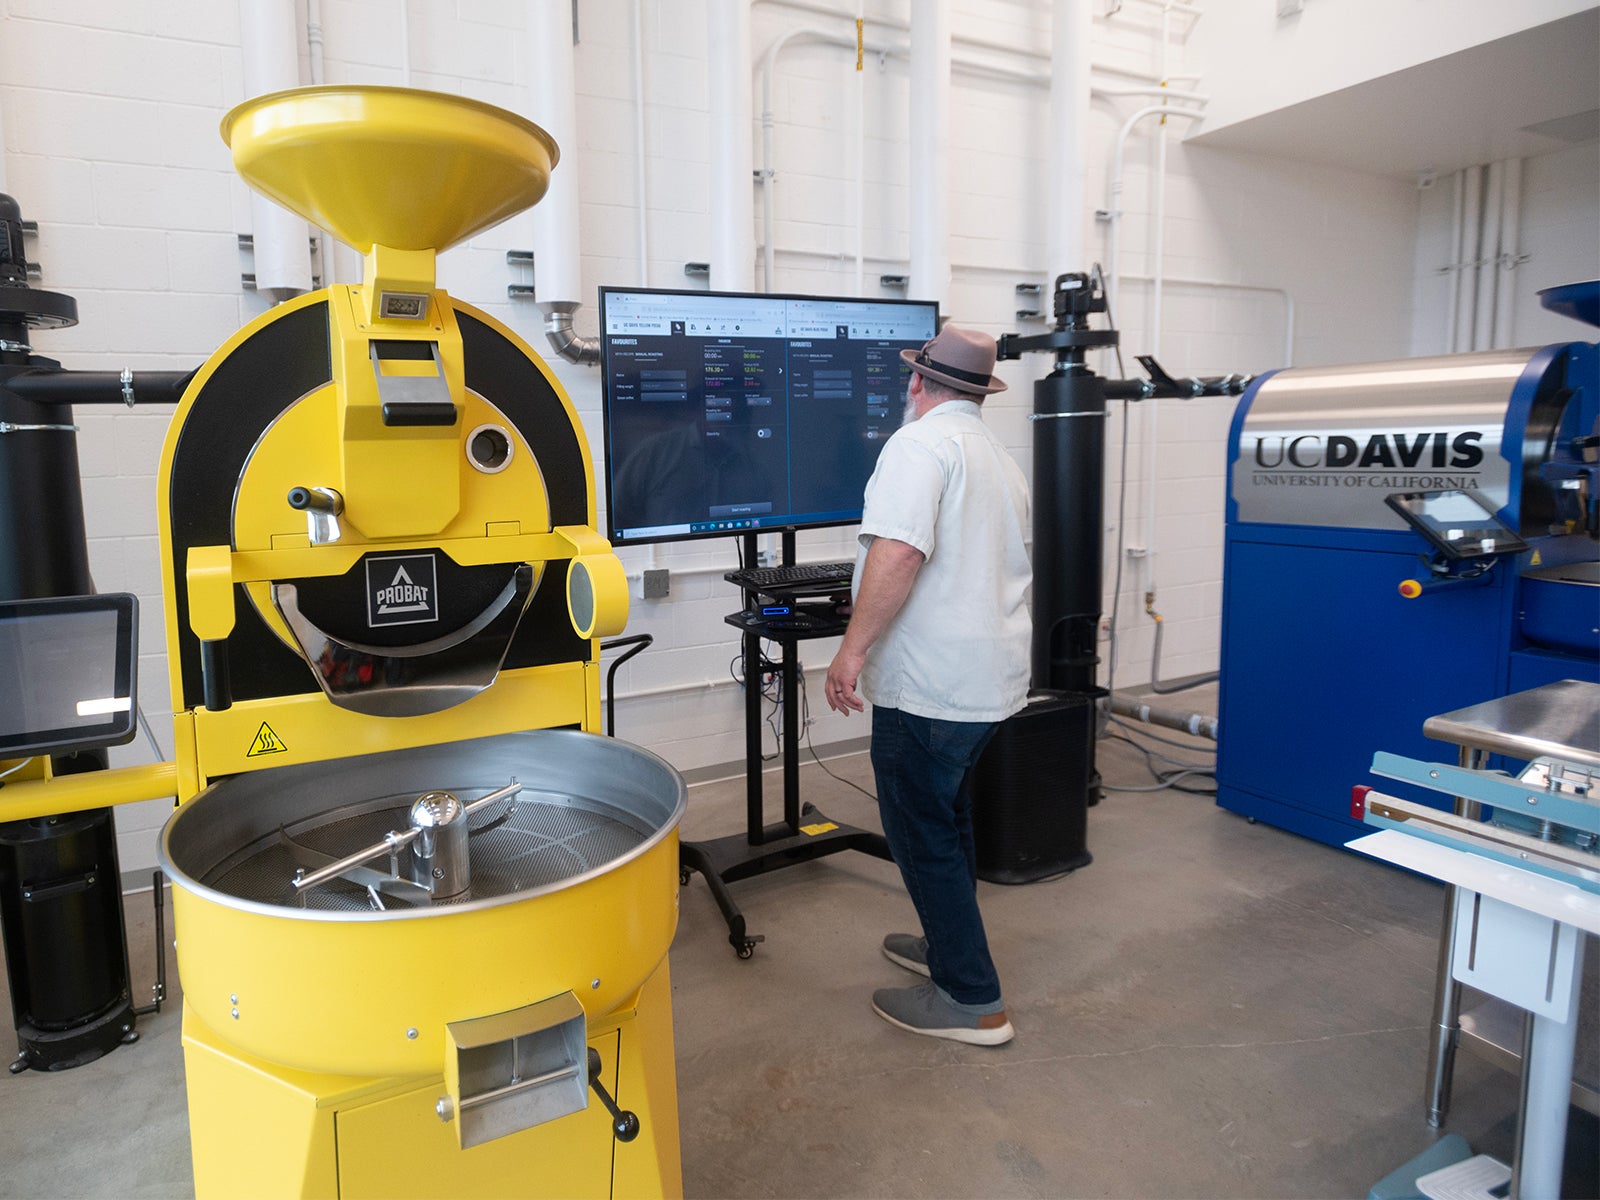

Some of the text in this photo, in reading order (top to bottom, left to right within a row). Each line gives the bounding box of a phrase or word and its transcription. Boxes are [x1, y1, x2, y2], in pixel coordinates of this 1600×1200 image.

[1252, 475, 1479, 489] UNIVERSITY OF CALIFORNIA
[376, 585, 428, 605] PROBAT
